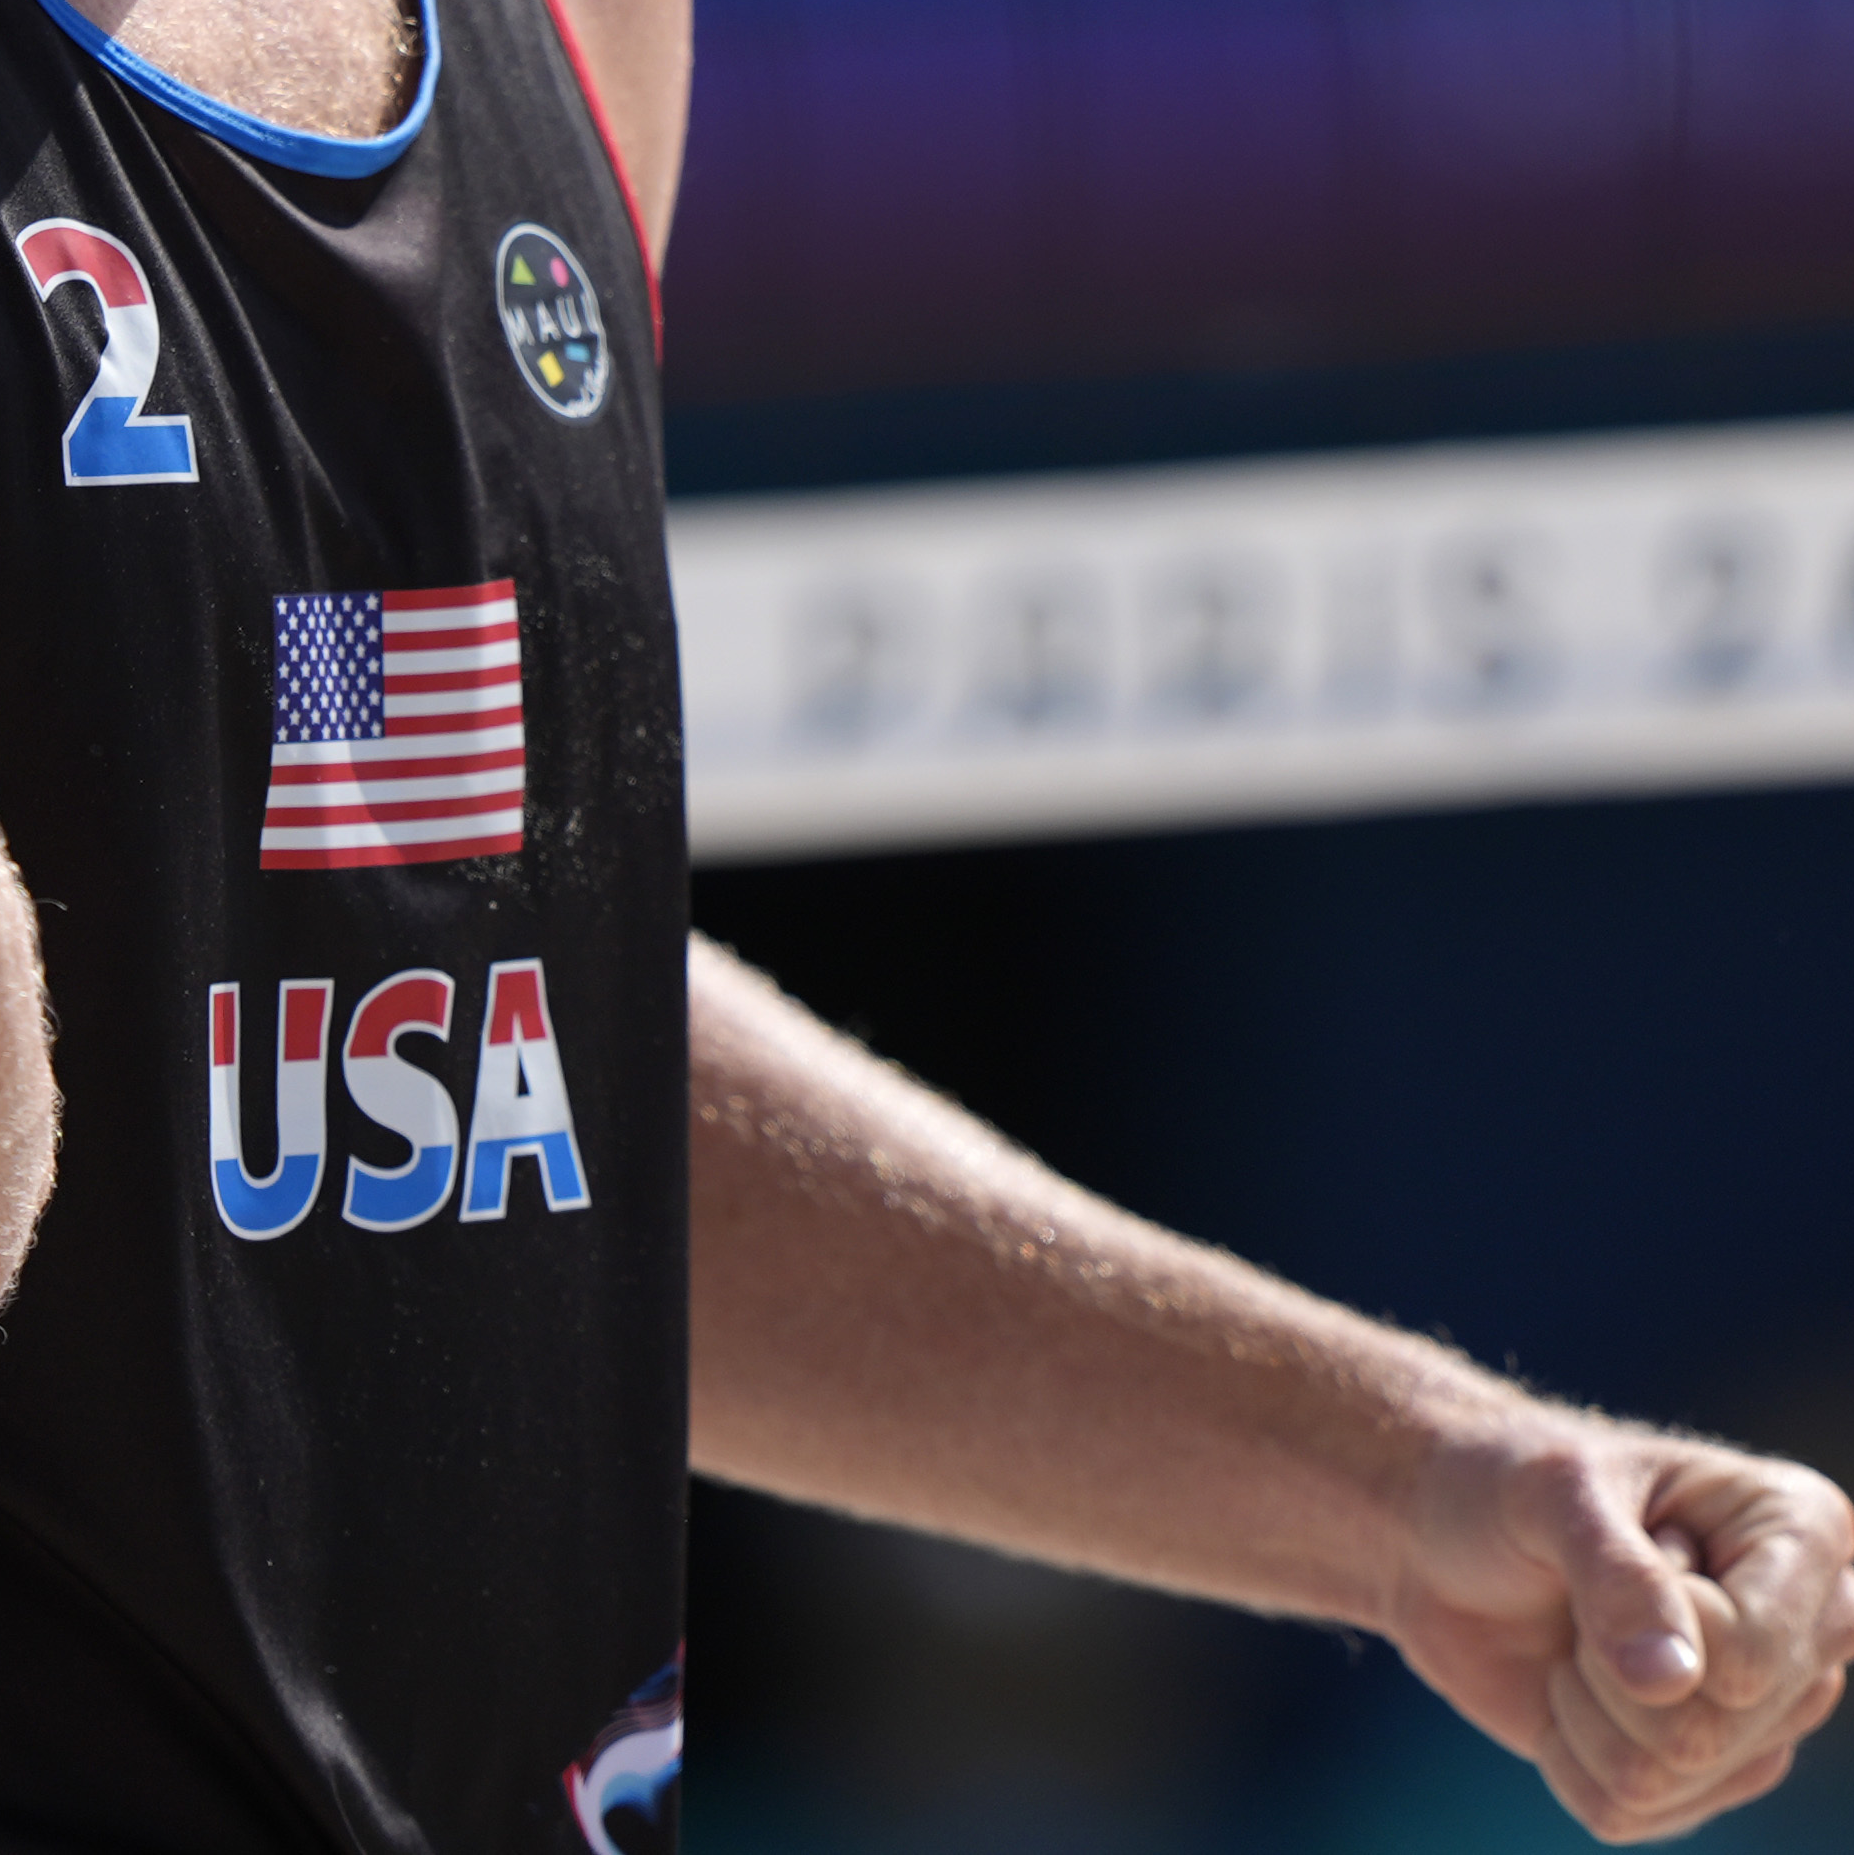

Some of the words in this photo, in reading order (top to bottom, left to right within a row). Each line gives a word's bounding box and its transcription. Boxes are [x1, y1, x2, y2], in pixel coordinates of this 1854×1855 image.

[15, 217, 199, 486] 2
[505, 292, 601, 346] MAUI
[208, 958, 592, 1240] USA
